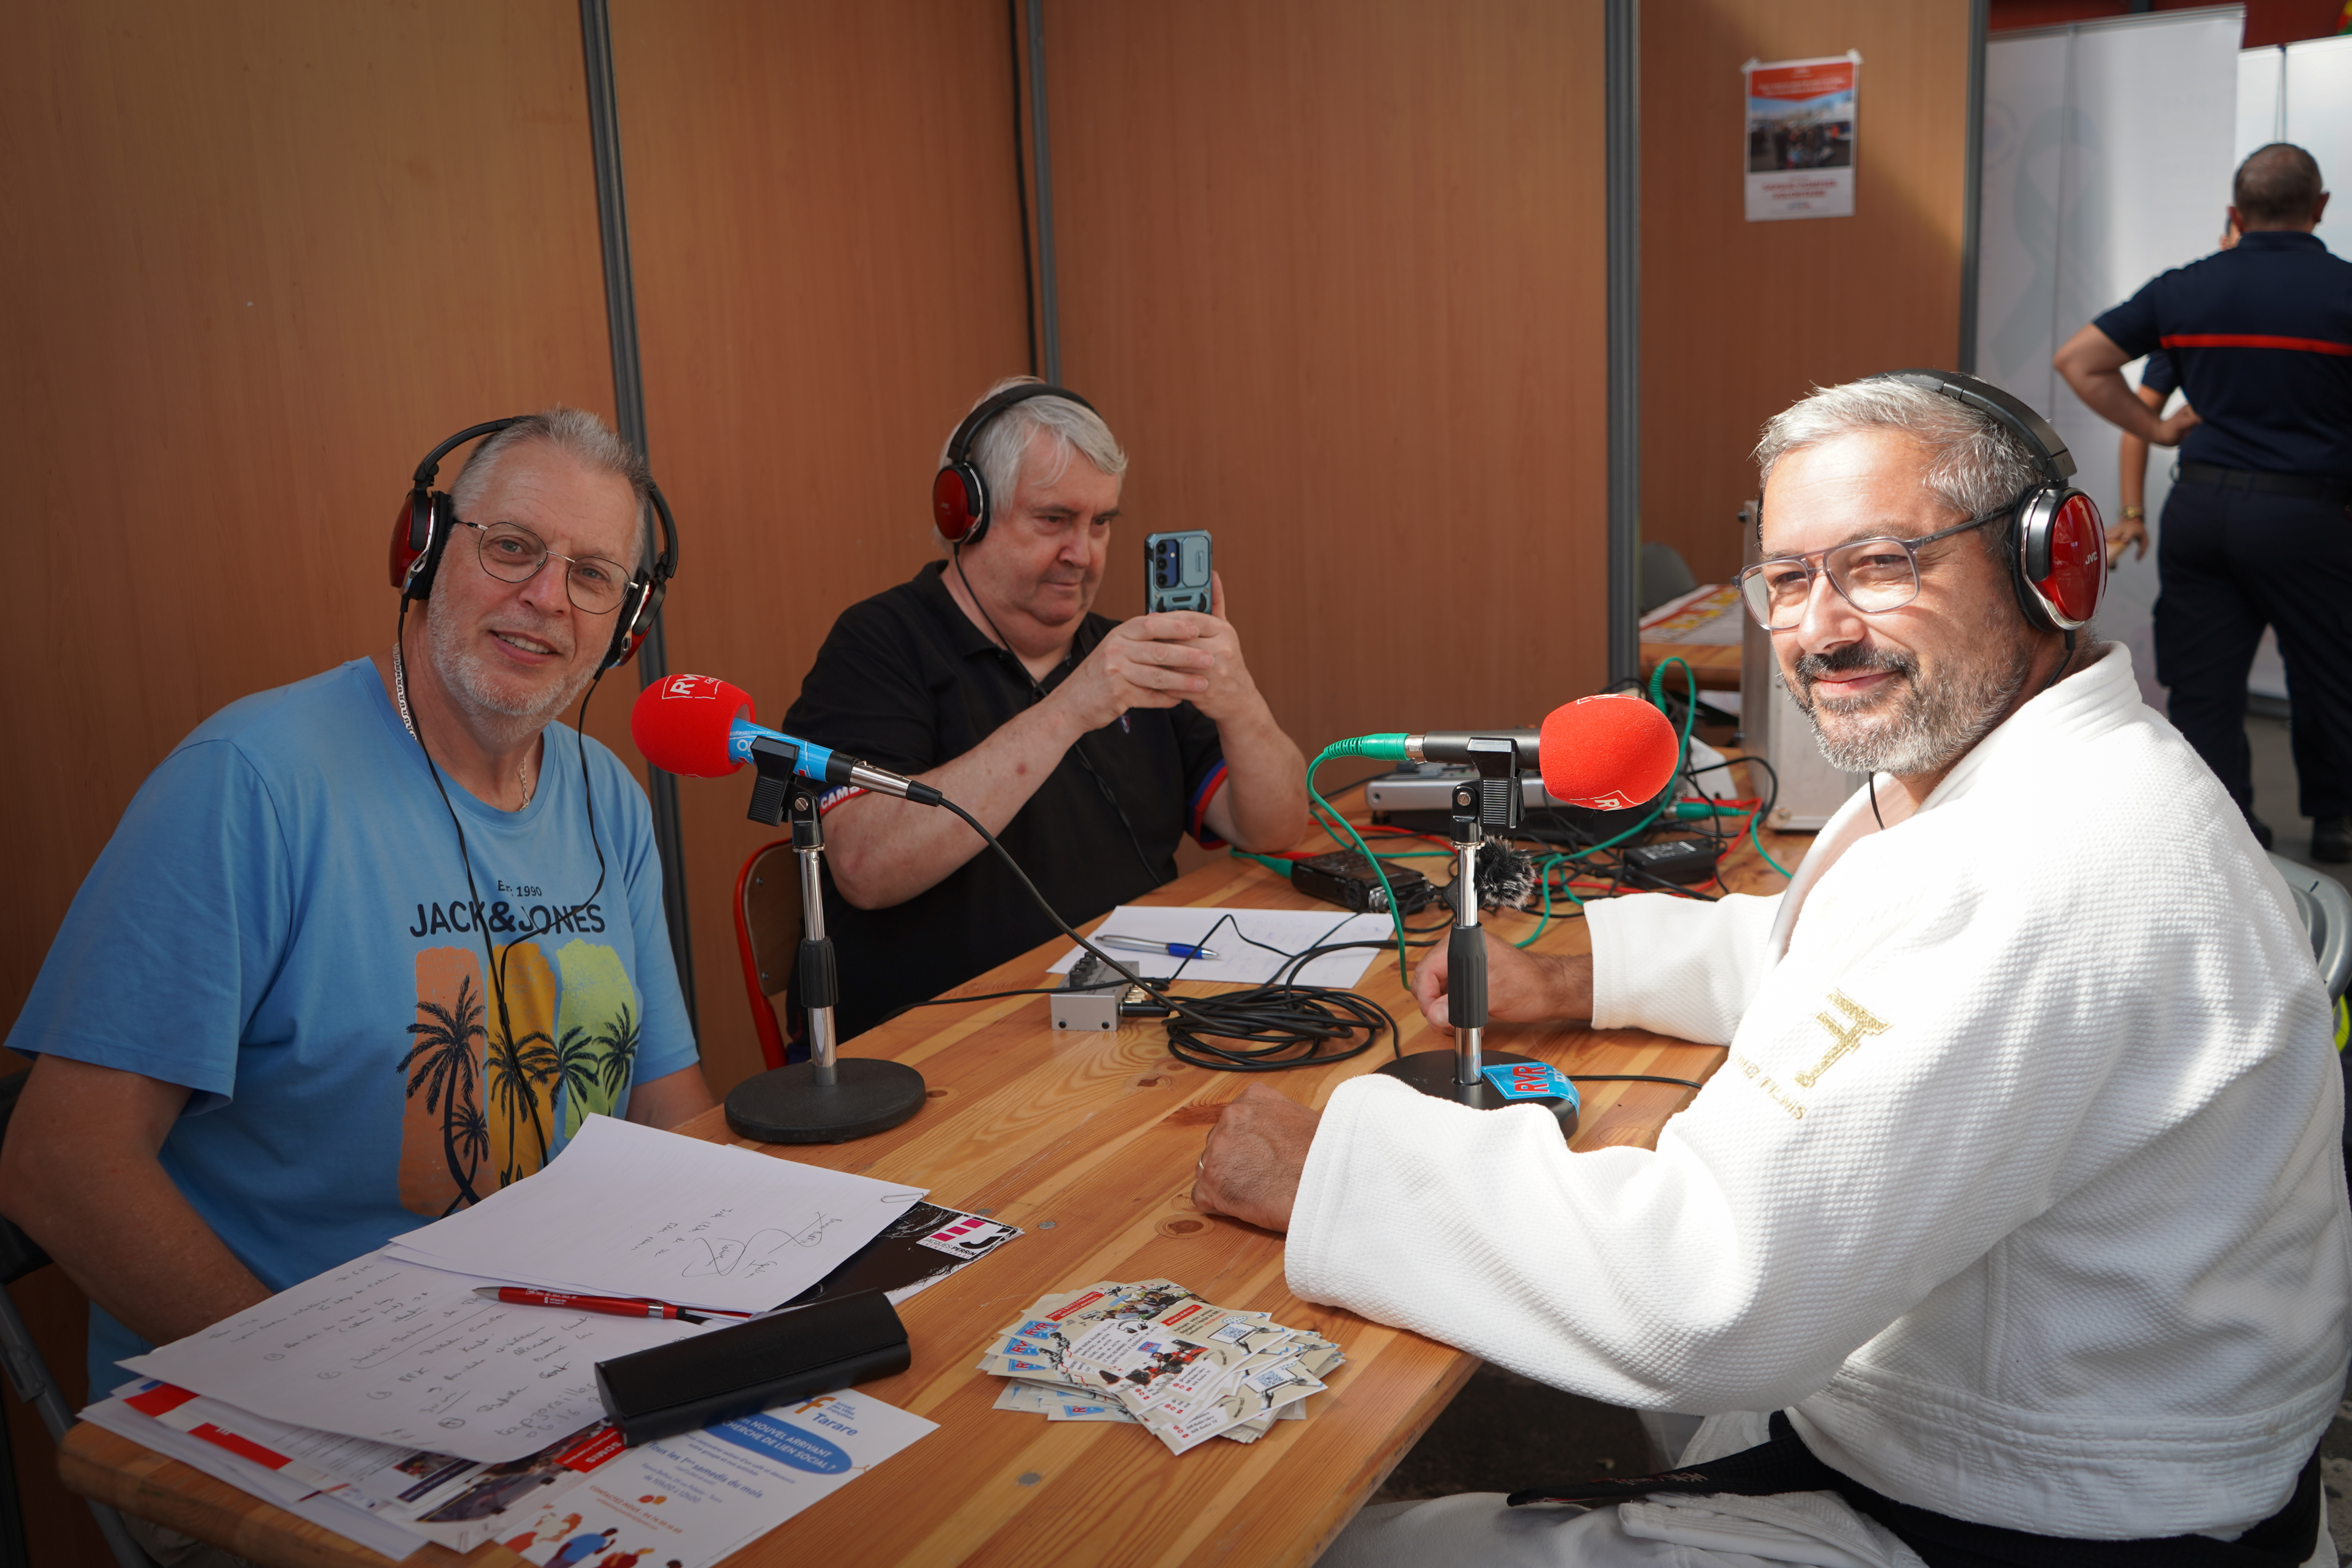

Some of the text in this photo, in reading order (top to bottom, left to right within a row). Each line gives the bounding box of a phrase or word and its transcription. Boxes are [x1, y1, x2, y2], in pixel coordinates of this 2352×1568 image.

[2085, 551, 2098, 565] JVC
[516, 886, 542, 896] 1990
[410, 901, 605, 937] JACK&JONES
[1512, 1066, 1550, 1093] RVR
[1758, 1077, 1808, 1121] FILMS
[1023, 1323, 1051, 1336] RVR
[1141, 1342, 1156, 1352] RVR
[812, 1413, 859, 1437] Tarare
[584, 1441, 622, 1464] SDMIS
[751, 1421, 788, 1442] NOUVEL
[784, 1436, 832, 1458] ARRIVANT
[761, 1436, 775, 1447] DE
[774, 1442, 796, 1457] LIEN
[793, 1449, 828, 1470] SOCIAL
[648, 1442, 667, 1455] Tous
[667, 1450, 681, 1461] les
[692, 1463, 728, 1483] samedis
[727, 1478, 741, 1489] du
[740, 1484, 764, 1499] mois
[687, 1442, 703, 1452] notre
[700, 1448, 721, 1460] groupe
[736, 1462, 759, 1476] activités
[696, 1438, 723, 1452] rencontrer
[722, 1449, 740, 1460] autour
[740, 1456, 752, 1465] d'un
[751, 1460, 764, 1469] café
[769, 1469, 796, 1484] découvrir
[589, 1485, 642, 1514] CONTACTEZ-NOUS
[652, 1477, 676, 1492] 10h00
[678, 1490, 702, 1503] 12h00
